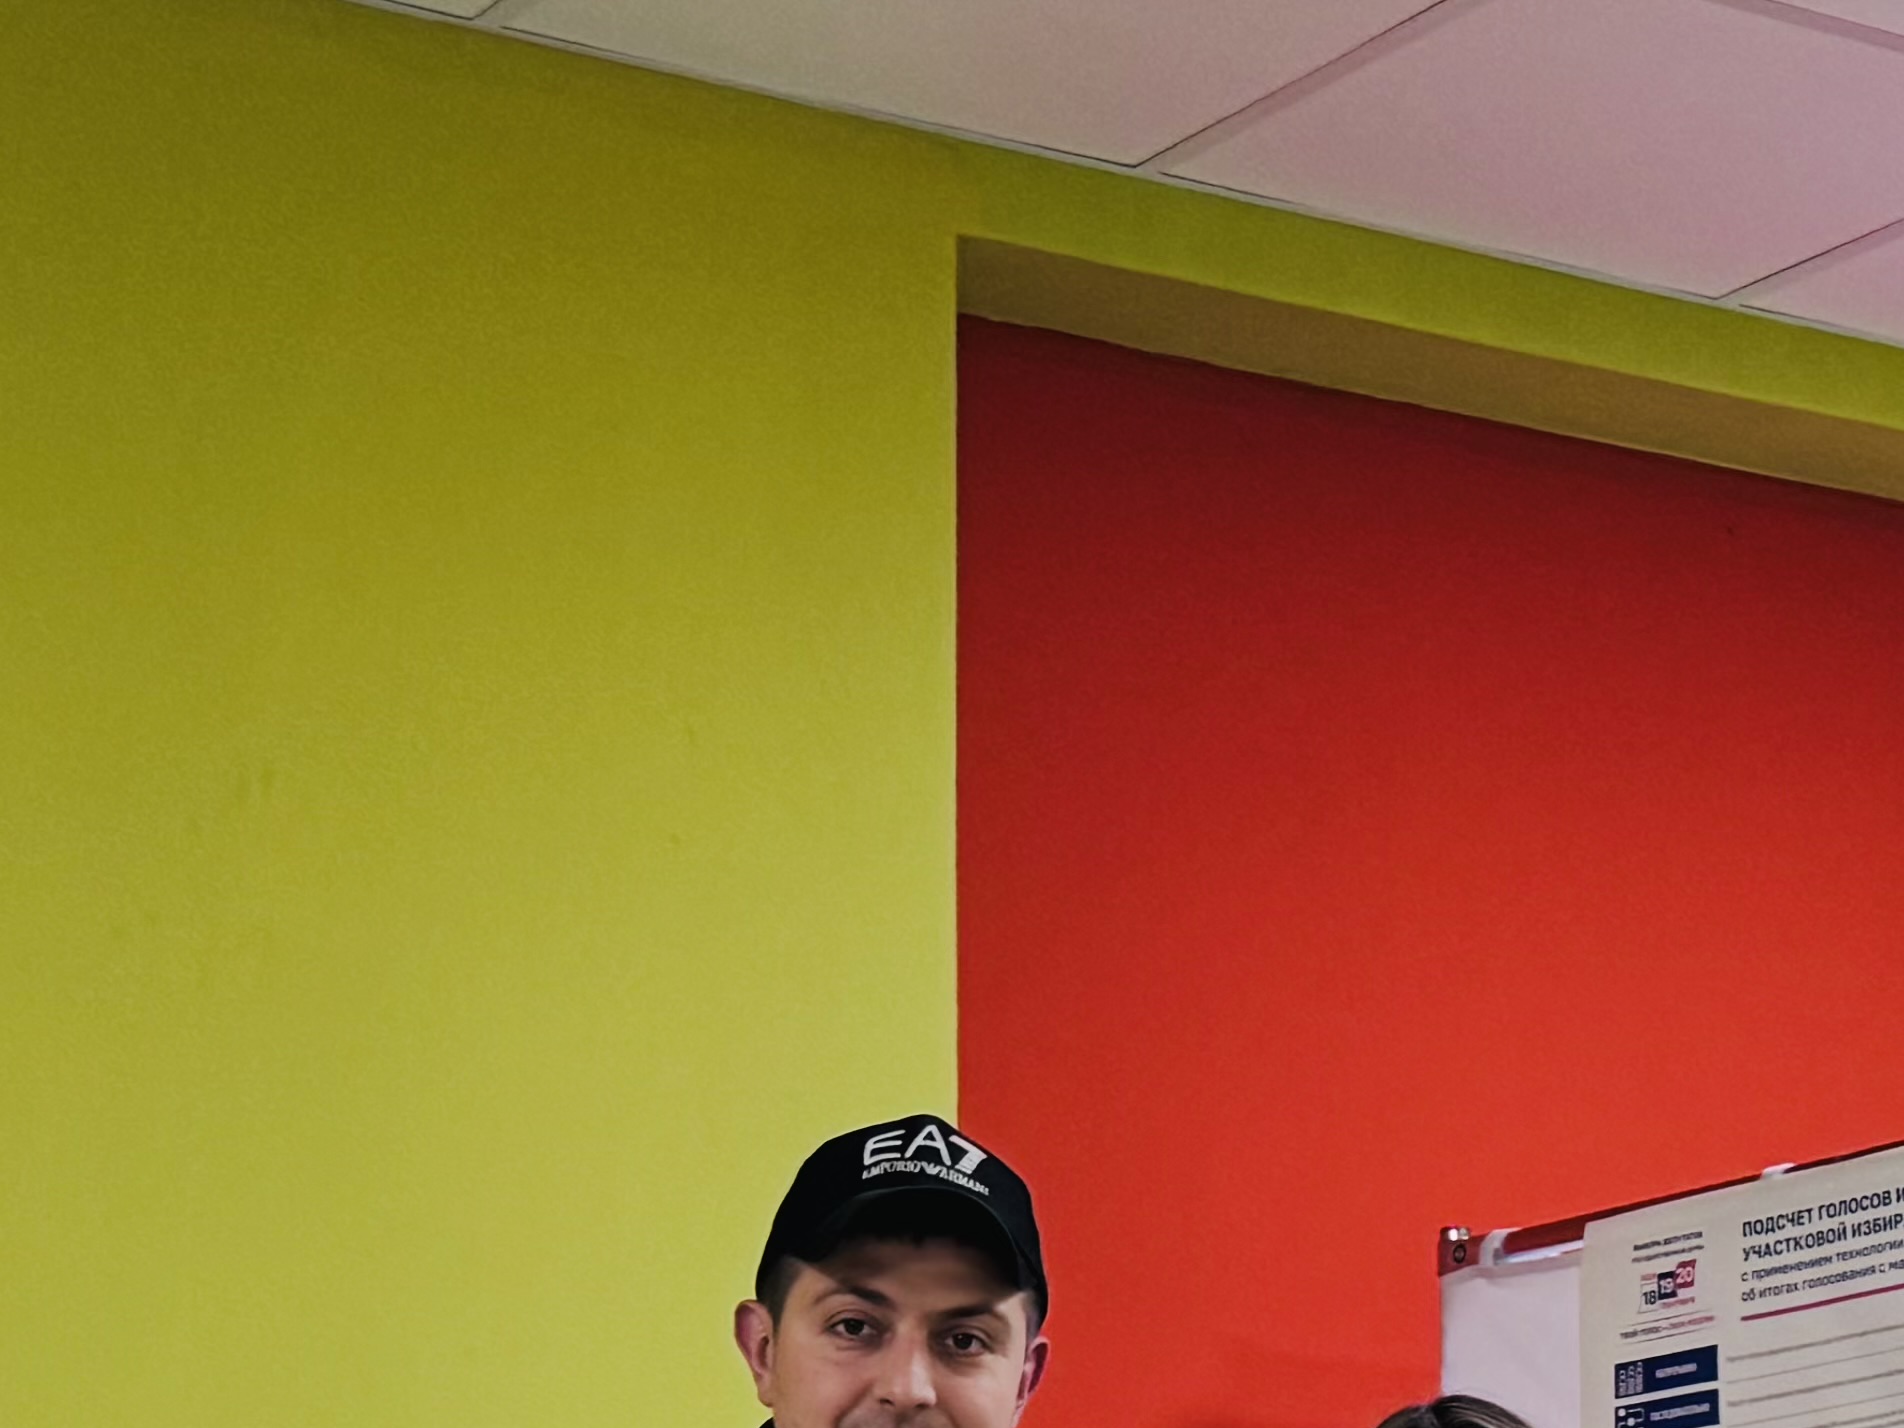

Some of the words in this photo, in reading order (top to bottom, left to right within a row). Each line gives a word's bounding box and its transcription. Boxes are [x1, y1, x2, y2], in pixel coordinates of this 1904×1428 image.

[863, 1124, 988, 1175] EA7
[1742, 1208, 1814, 1238] ПОДСЧЕТ
[1818, 1190, 1892, 1221] ГОЛОСОВ
[1742, 1222, 1848, 1262] УЧАСТКОВОЙ
[1751, 1255, 1833, 1281] применением
[1836, 1238, 1904, 1262] технологии
[1675, 1266, 1694, 1284] 20
[1741, 1288, 1756, 1302] об
[1759, 1282, 1800, 1299] итогах
[1802, 1265, 1876, 1290] голосования
